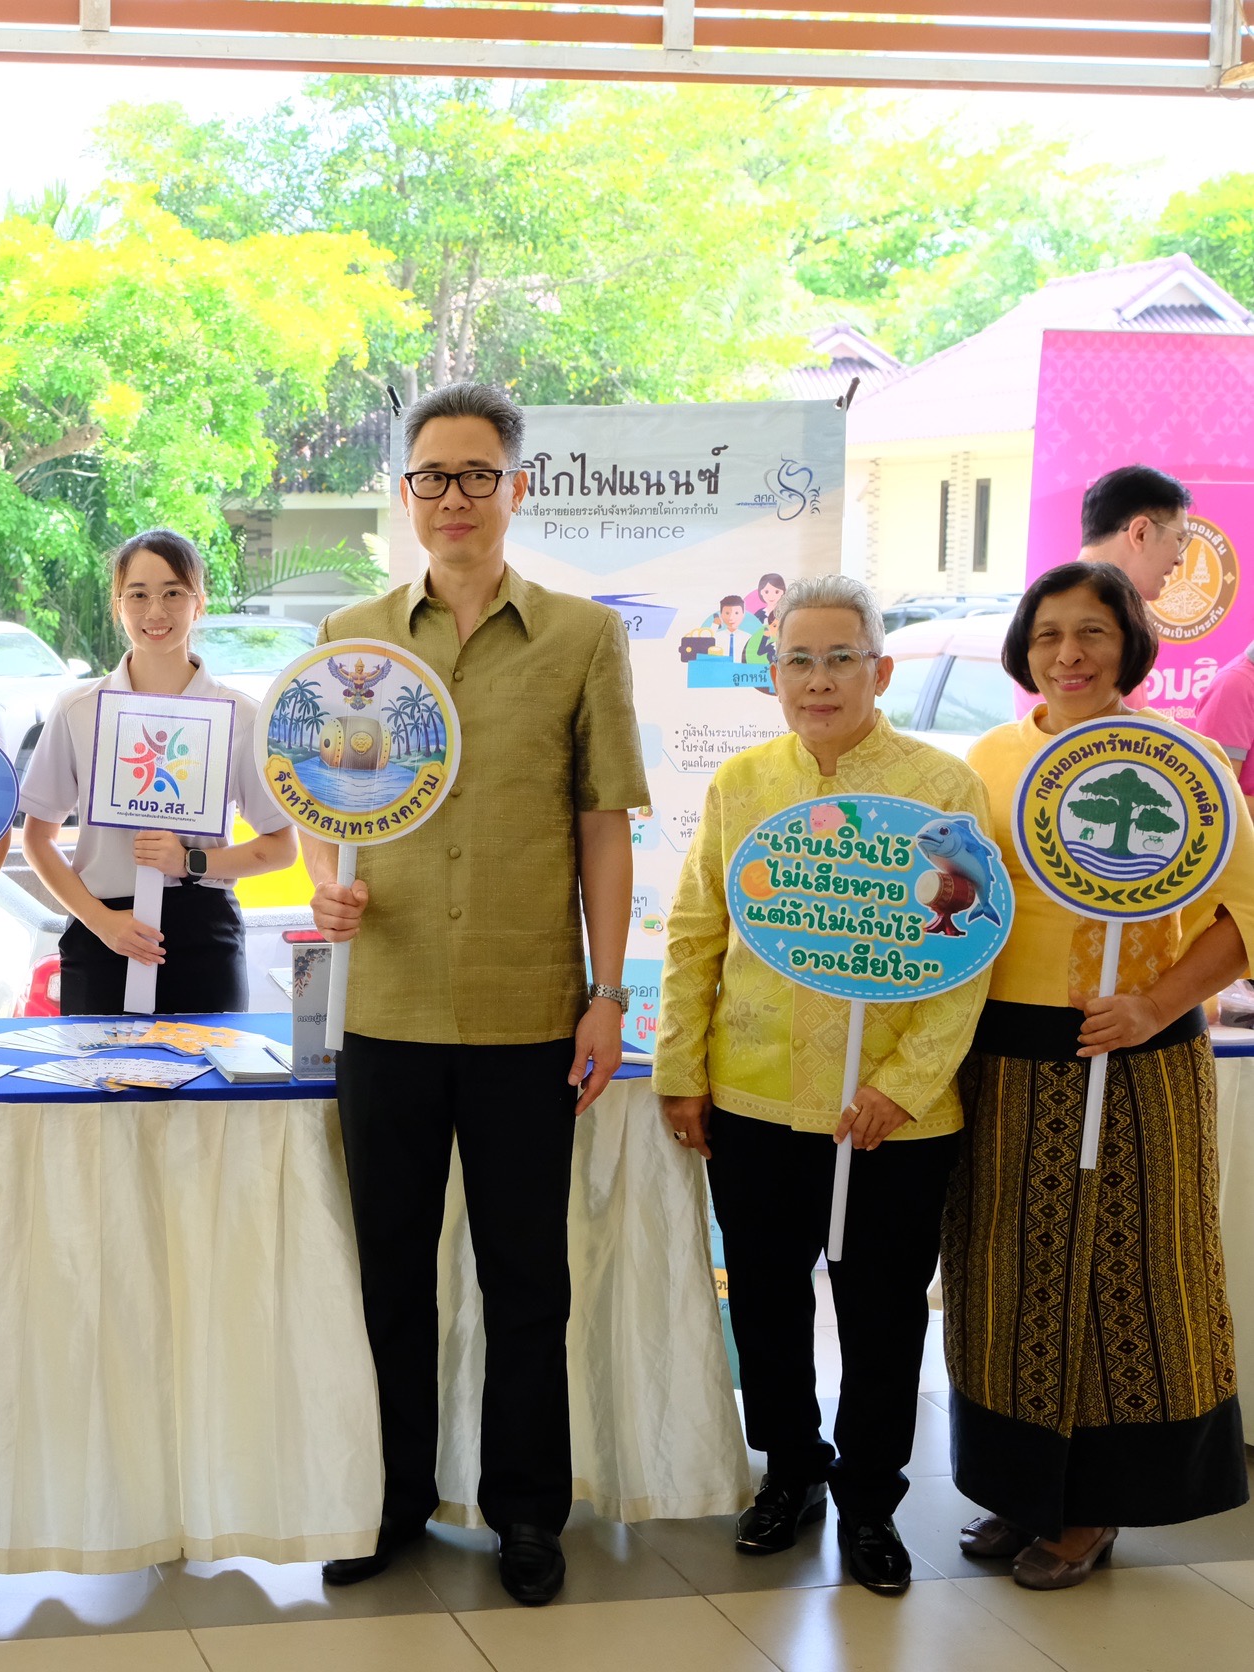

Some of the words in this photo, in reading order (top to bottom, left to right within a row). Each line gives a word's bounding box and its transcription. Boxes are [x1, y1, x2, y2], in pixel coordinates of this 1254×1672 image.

[544, 521, 589, 539] Pico
[601, 521, 685, 539] Finance
[1036, 733, 1218, 827] กลุ่มออมทรัพย์เพื่อการผลิต
[128, 799, 189, 816] คบจ.สส.
[274, 770, 440, 839] จังหวัดสมุทรสงคราม
[756, 820, 912, 867] "เก็บเงินไว้
[766, 858, 905, 902] ไม่เสียหาย
[746, 899, 923, 942] แต่ถ้าไม่เก็บไว้
[791, 943, 939, 981] อาจเสียใจ"
